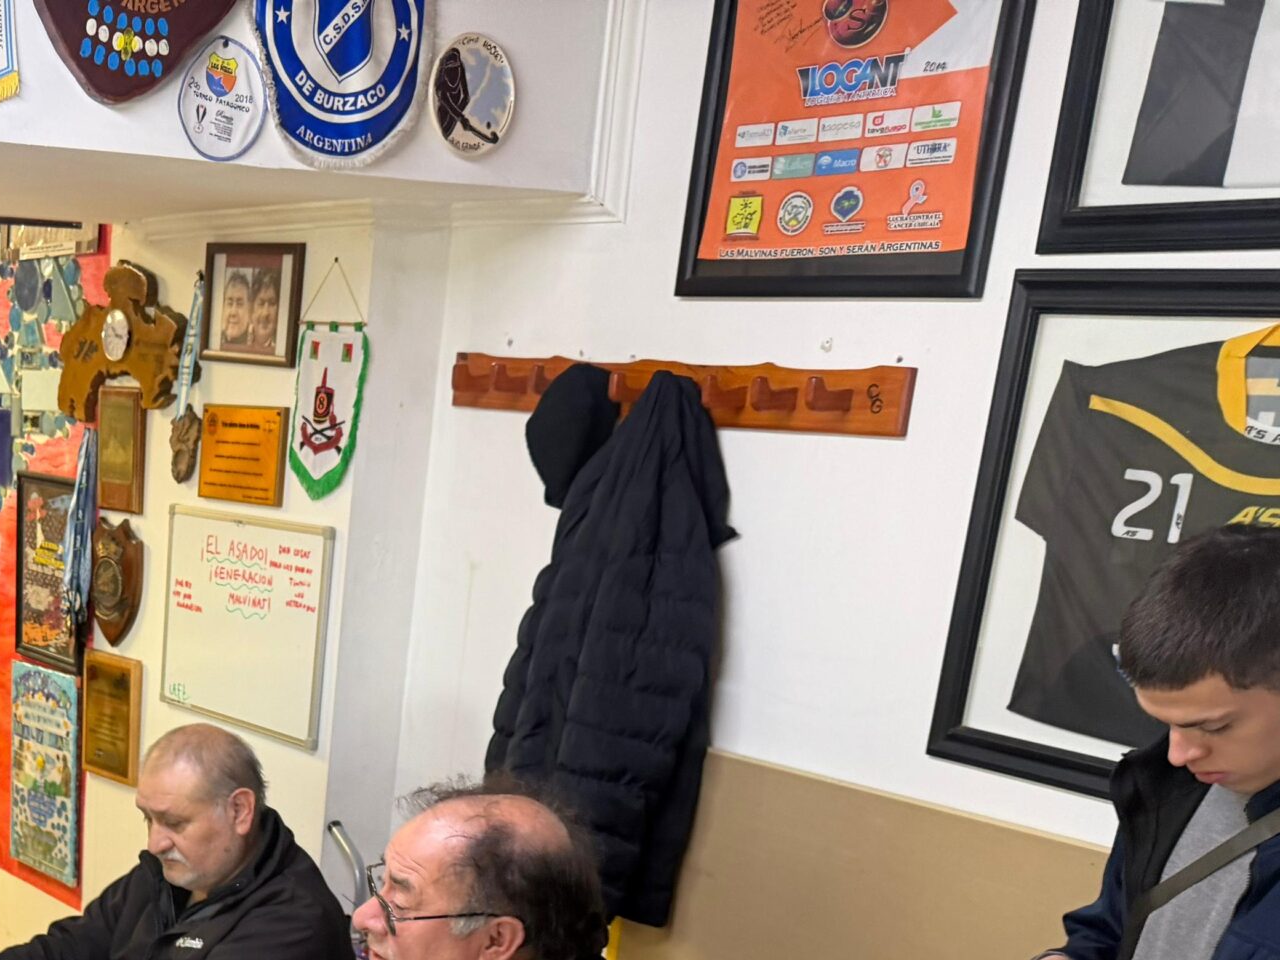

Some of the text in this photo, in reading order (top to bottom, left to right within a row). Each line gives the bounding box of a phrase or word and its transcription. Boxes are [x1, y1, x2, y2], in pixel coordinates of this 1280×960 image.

[322, 0, 371, 46] C.S.D.S.
[294, 69, 386, 111] DE BURZACO
[296, 125, 373, 153] ARGENTINA
[719, 249, 735, 258] LAS
[736, 248, 778, 258] MALVINAS
[818, 247, 837, 256] SON
[878, 240, 941, 253] ARGENTINAS
[1111, 468, 1194, 544] 21
